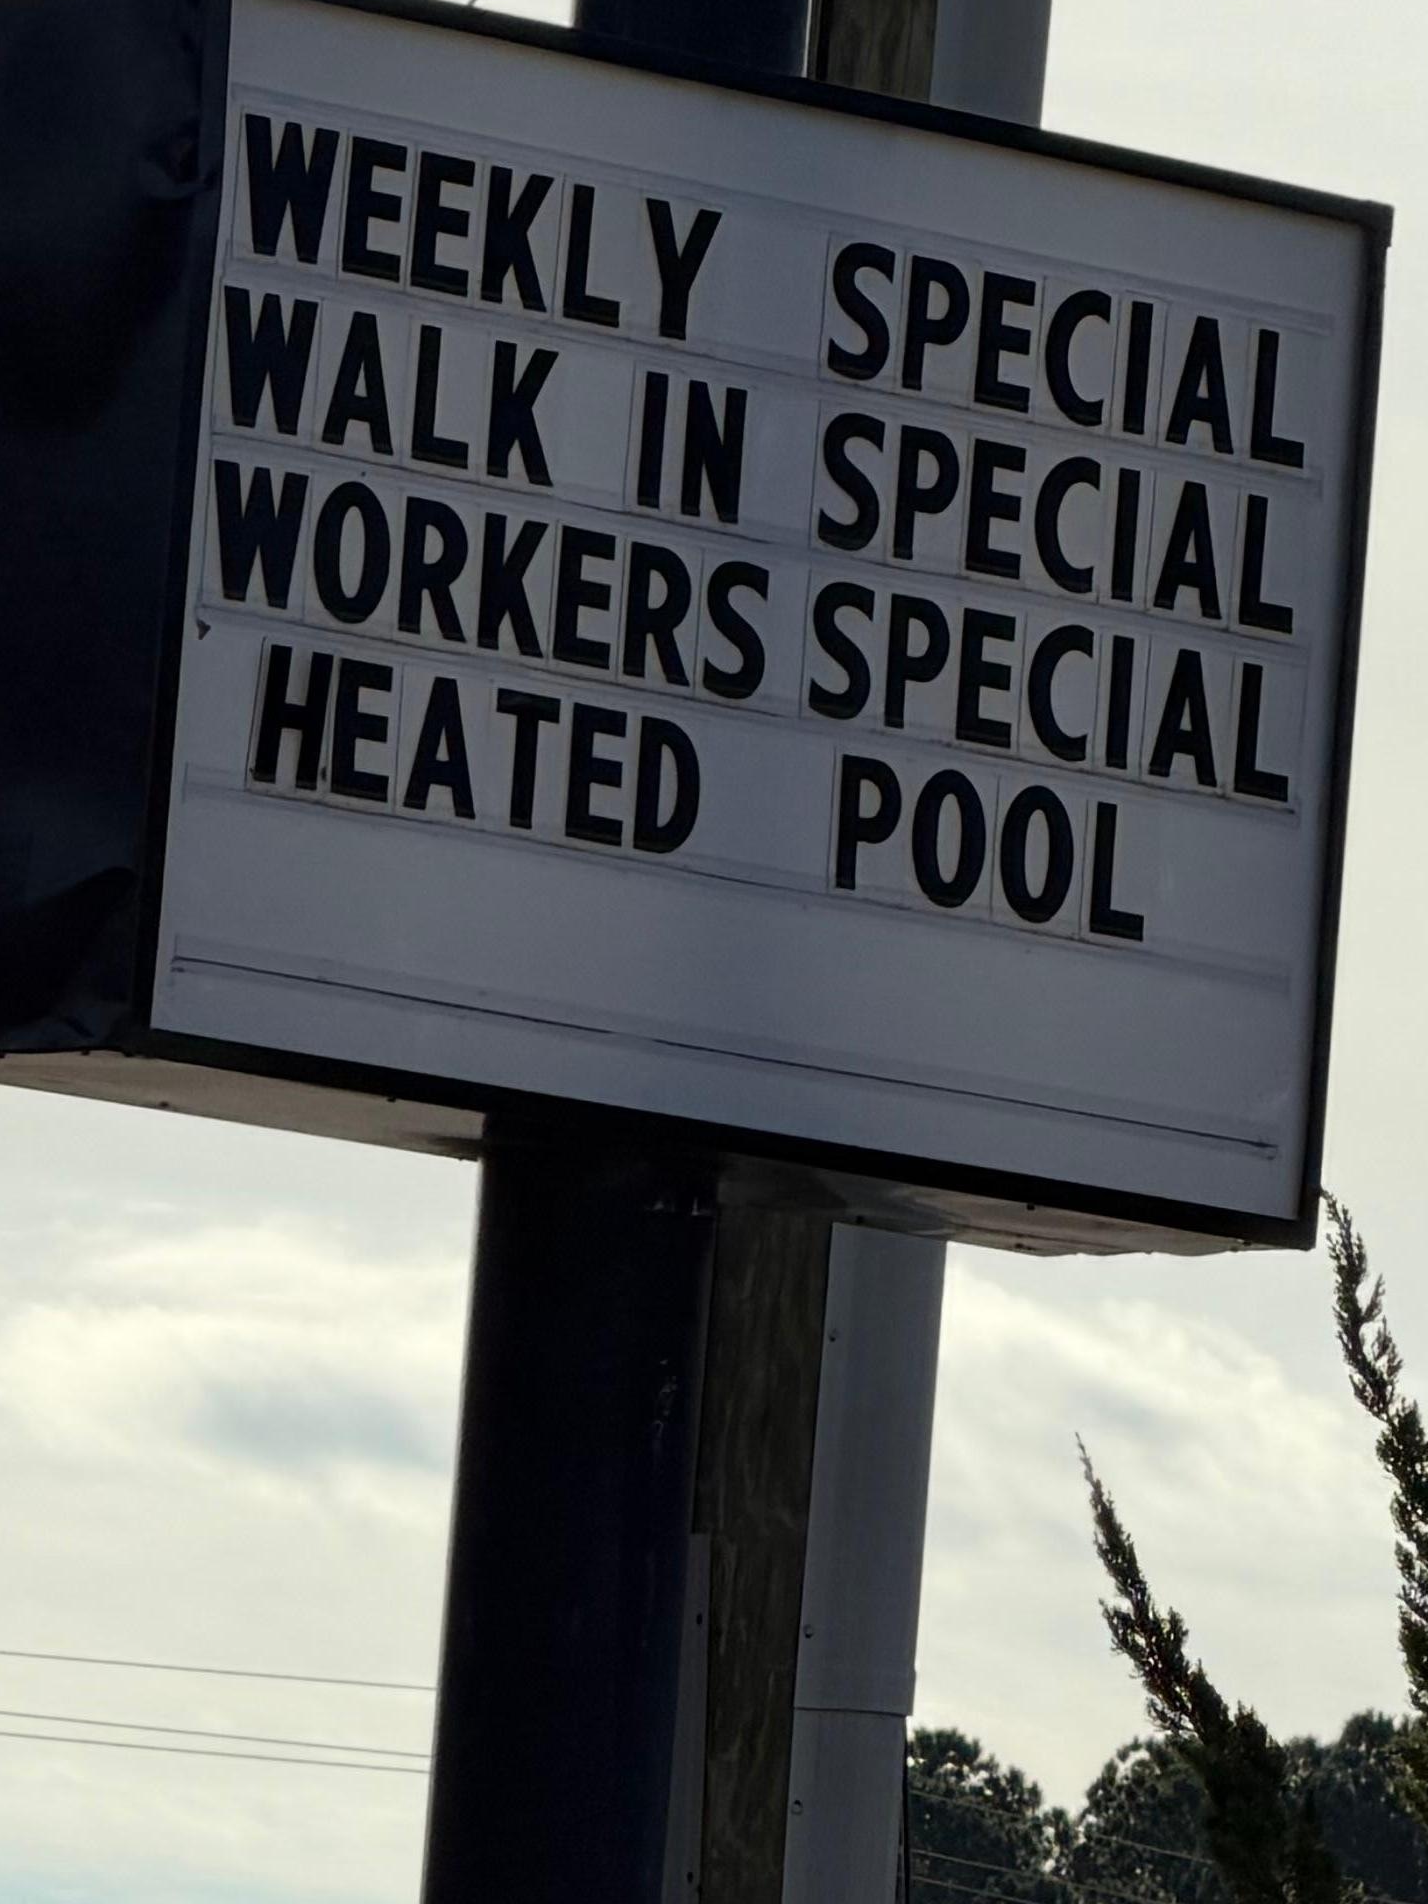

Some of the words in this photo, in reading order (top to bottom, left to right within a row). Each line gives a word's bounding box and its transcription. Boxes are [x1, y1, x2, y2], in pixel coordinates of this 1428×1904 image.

[223, 285, 561, 489] WALK
[635, 371, 748, 525] IN
[815, 412, 1294, 635] SPECIAL
[243, 113, 723, 342] WEEKLY
[828, 241, 1306, 469] SPECIAL
[213, 458, 771, 700] WORKERS
[806, 583, 1291, 804] SPECIAL
[250, 643, 702, 855] HEATED
[833, 754, 1146, 944] POOL
